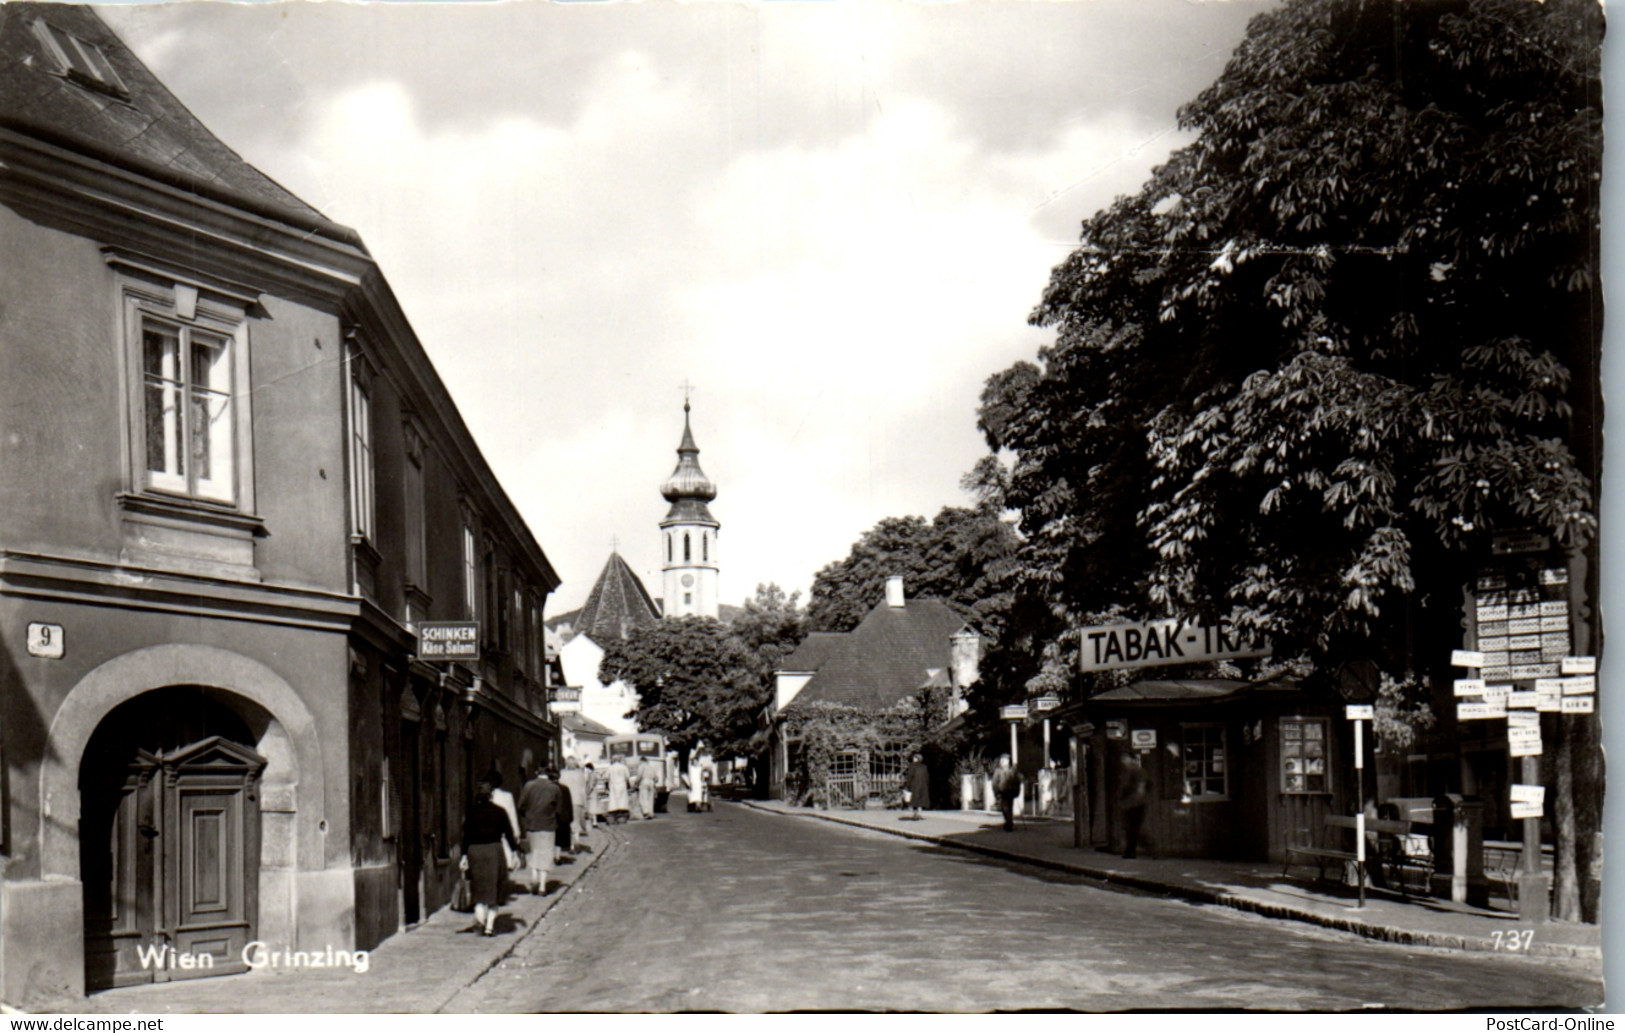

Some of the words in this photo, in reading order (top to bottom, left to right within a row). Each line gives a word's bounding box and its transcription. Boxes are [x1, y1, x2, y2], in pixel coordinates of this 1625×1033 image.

[41, 625, 51, 646] 9
[422, 627, 476, 640] SCHINKEN
[446, 640, 476, 654] Salami
